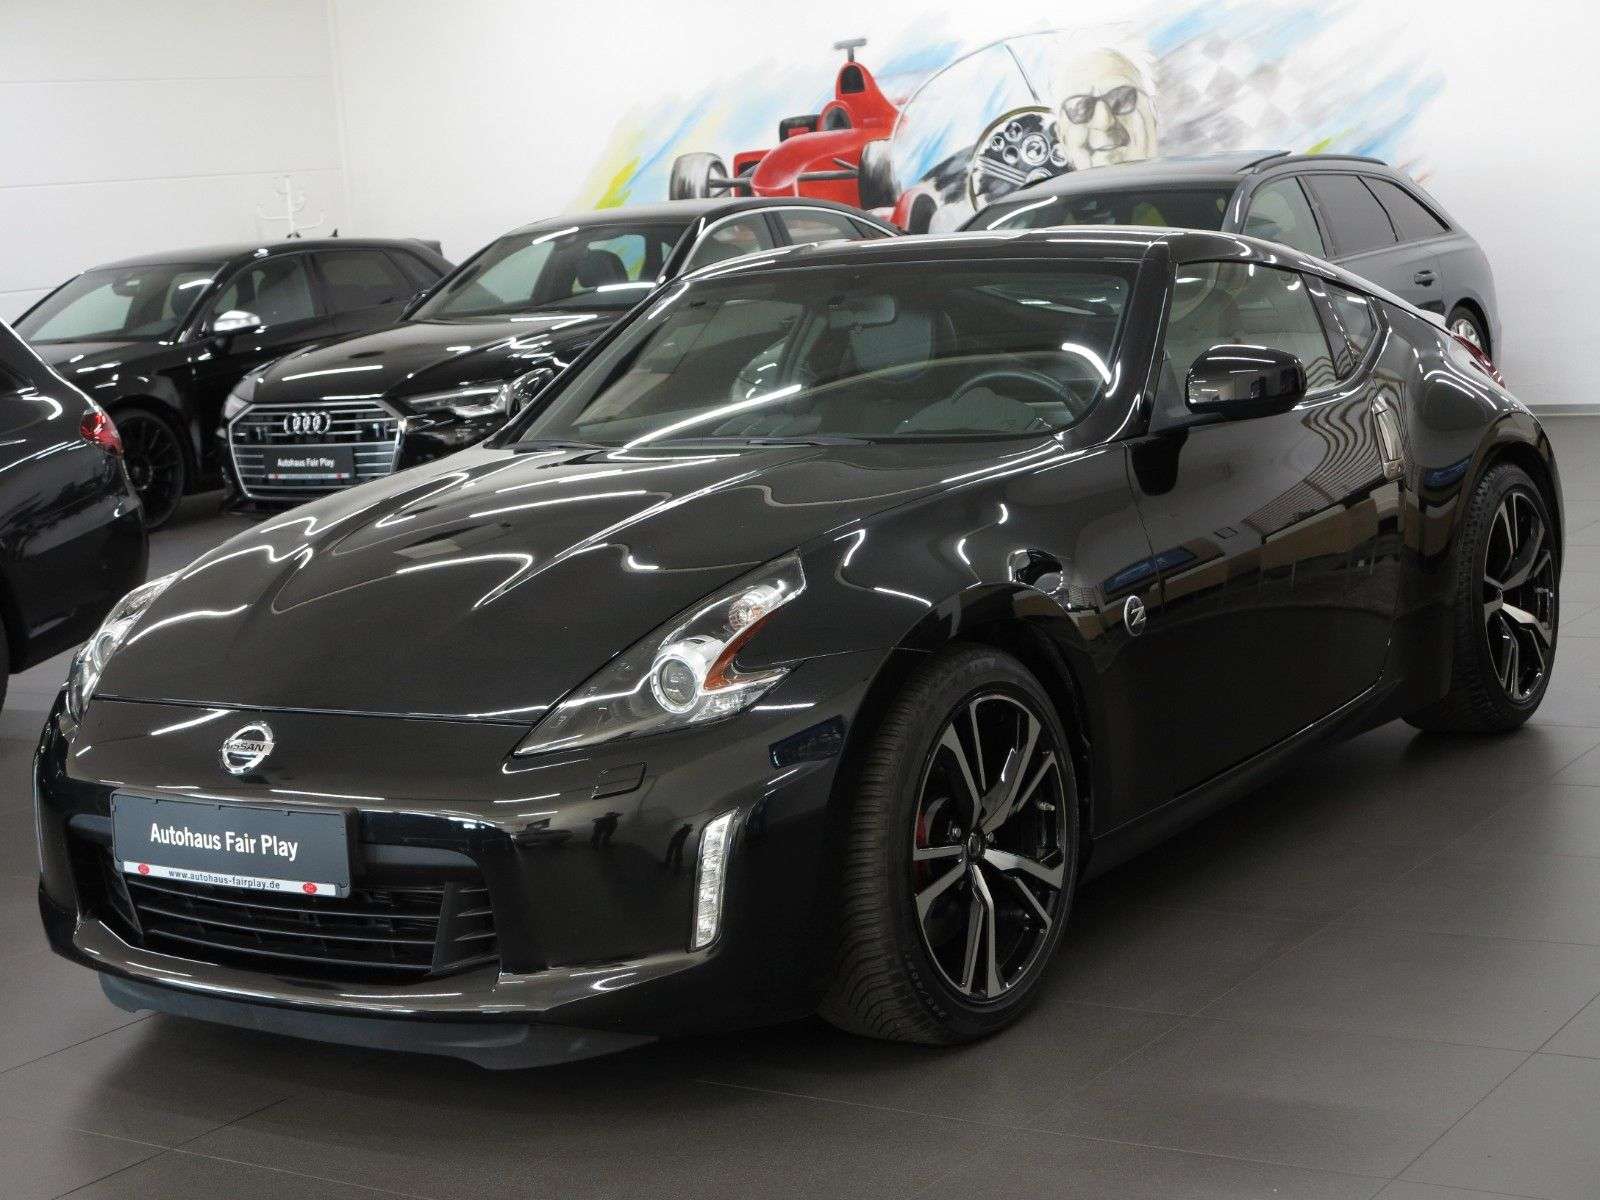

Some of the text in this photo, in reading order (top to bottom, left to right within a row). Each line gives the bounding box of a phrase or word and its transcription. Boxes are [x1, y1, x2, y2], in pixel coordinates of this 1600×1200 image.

[277, 457, 335, 468] Autohaus Fair Play
[150, 822, 298, 862] Autohaus Fair Play
[168, 868, 281, 891] www.autohaus-fairplay.de
